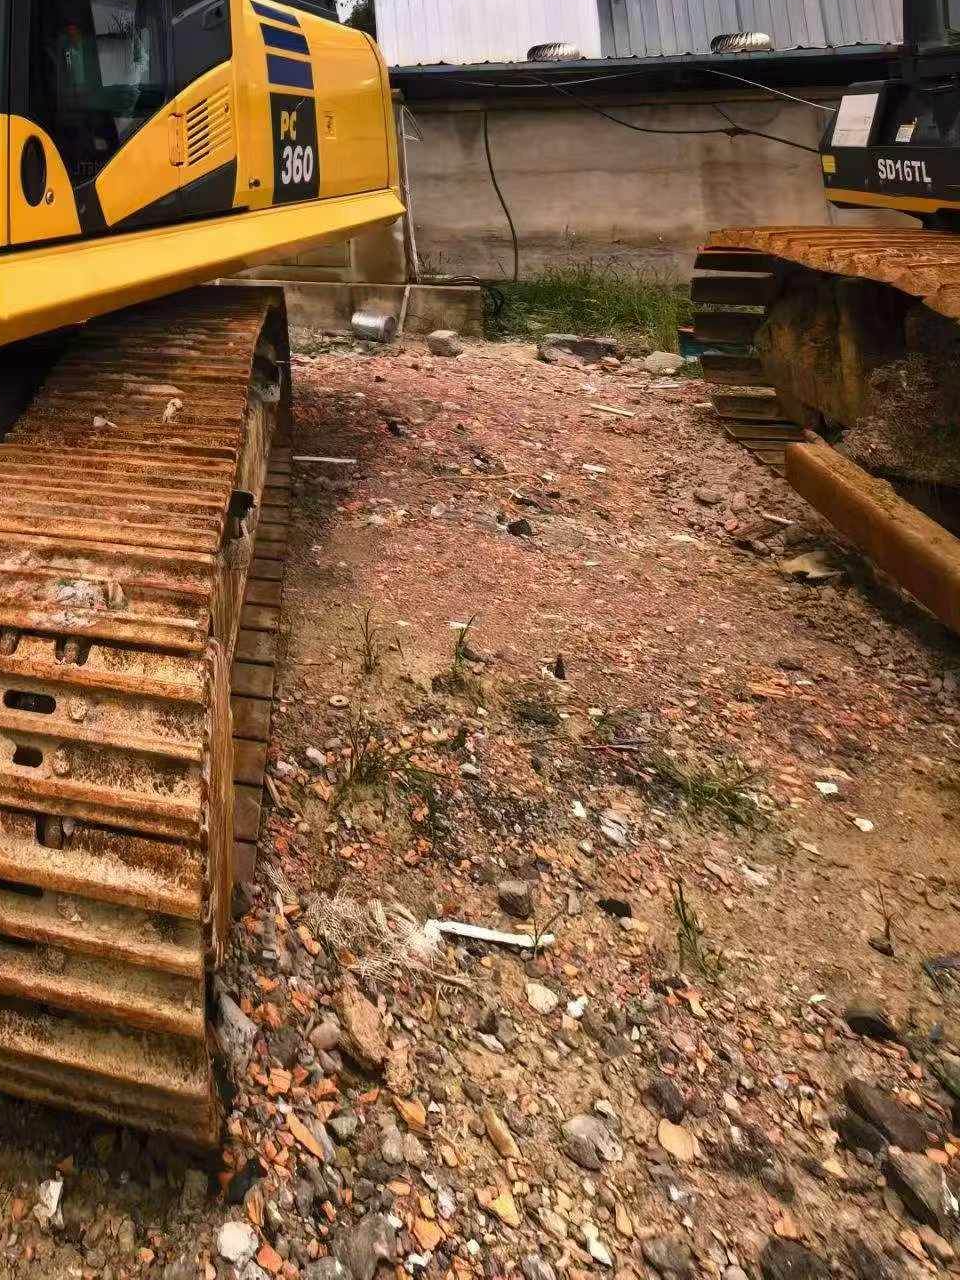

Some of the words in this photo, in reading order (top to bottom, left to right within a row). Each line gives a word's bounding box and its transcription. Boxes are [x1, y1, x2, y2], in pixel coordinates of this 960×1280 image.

[281, 111, 297, 140] PC
[281, 146, 314, 185] 360
[877, 159, 932, 183] SD16TL
